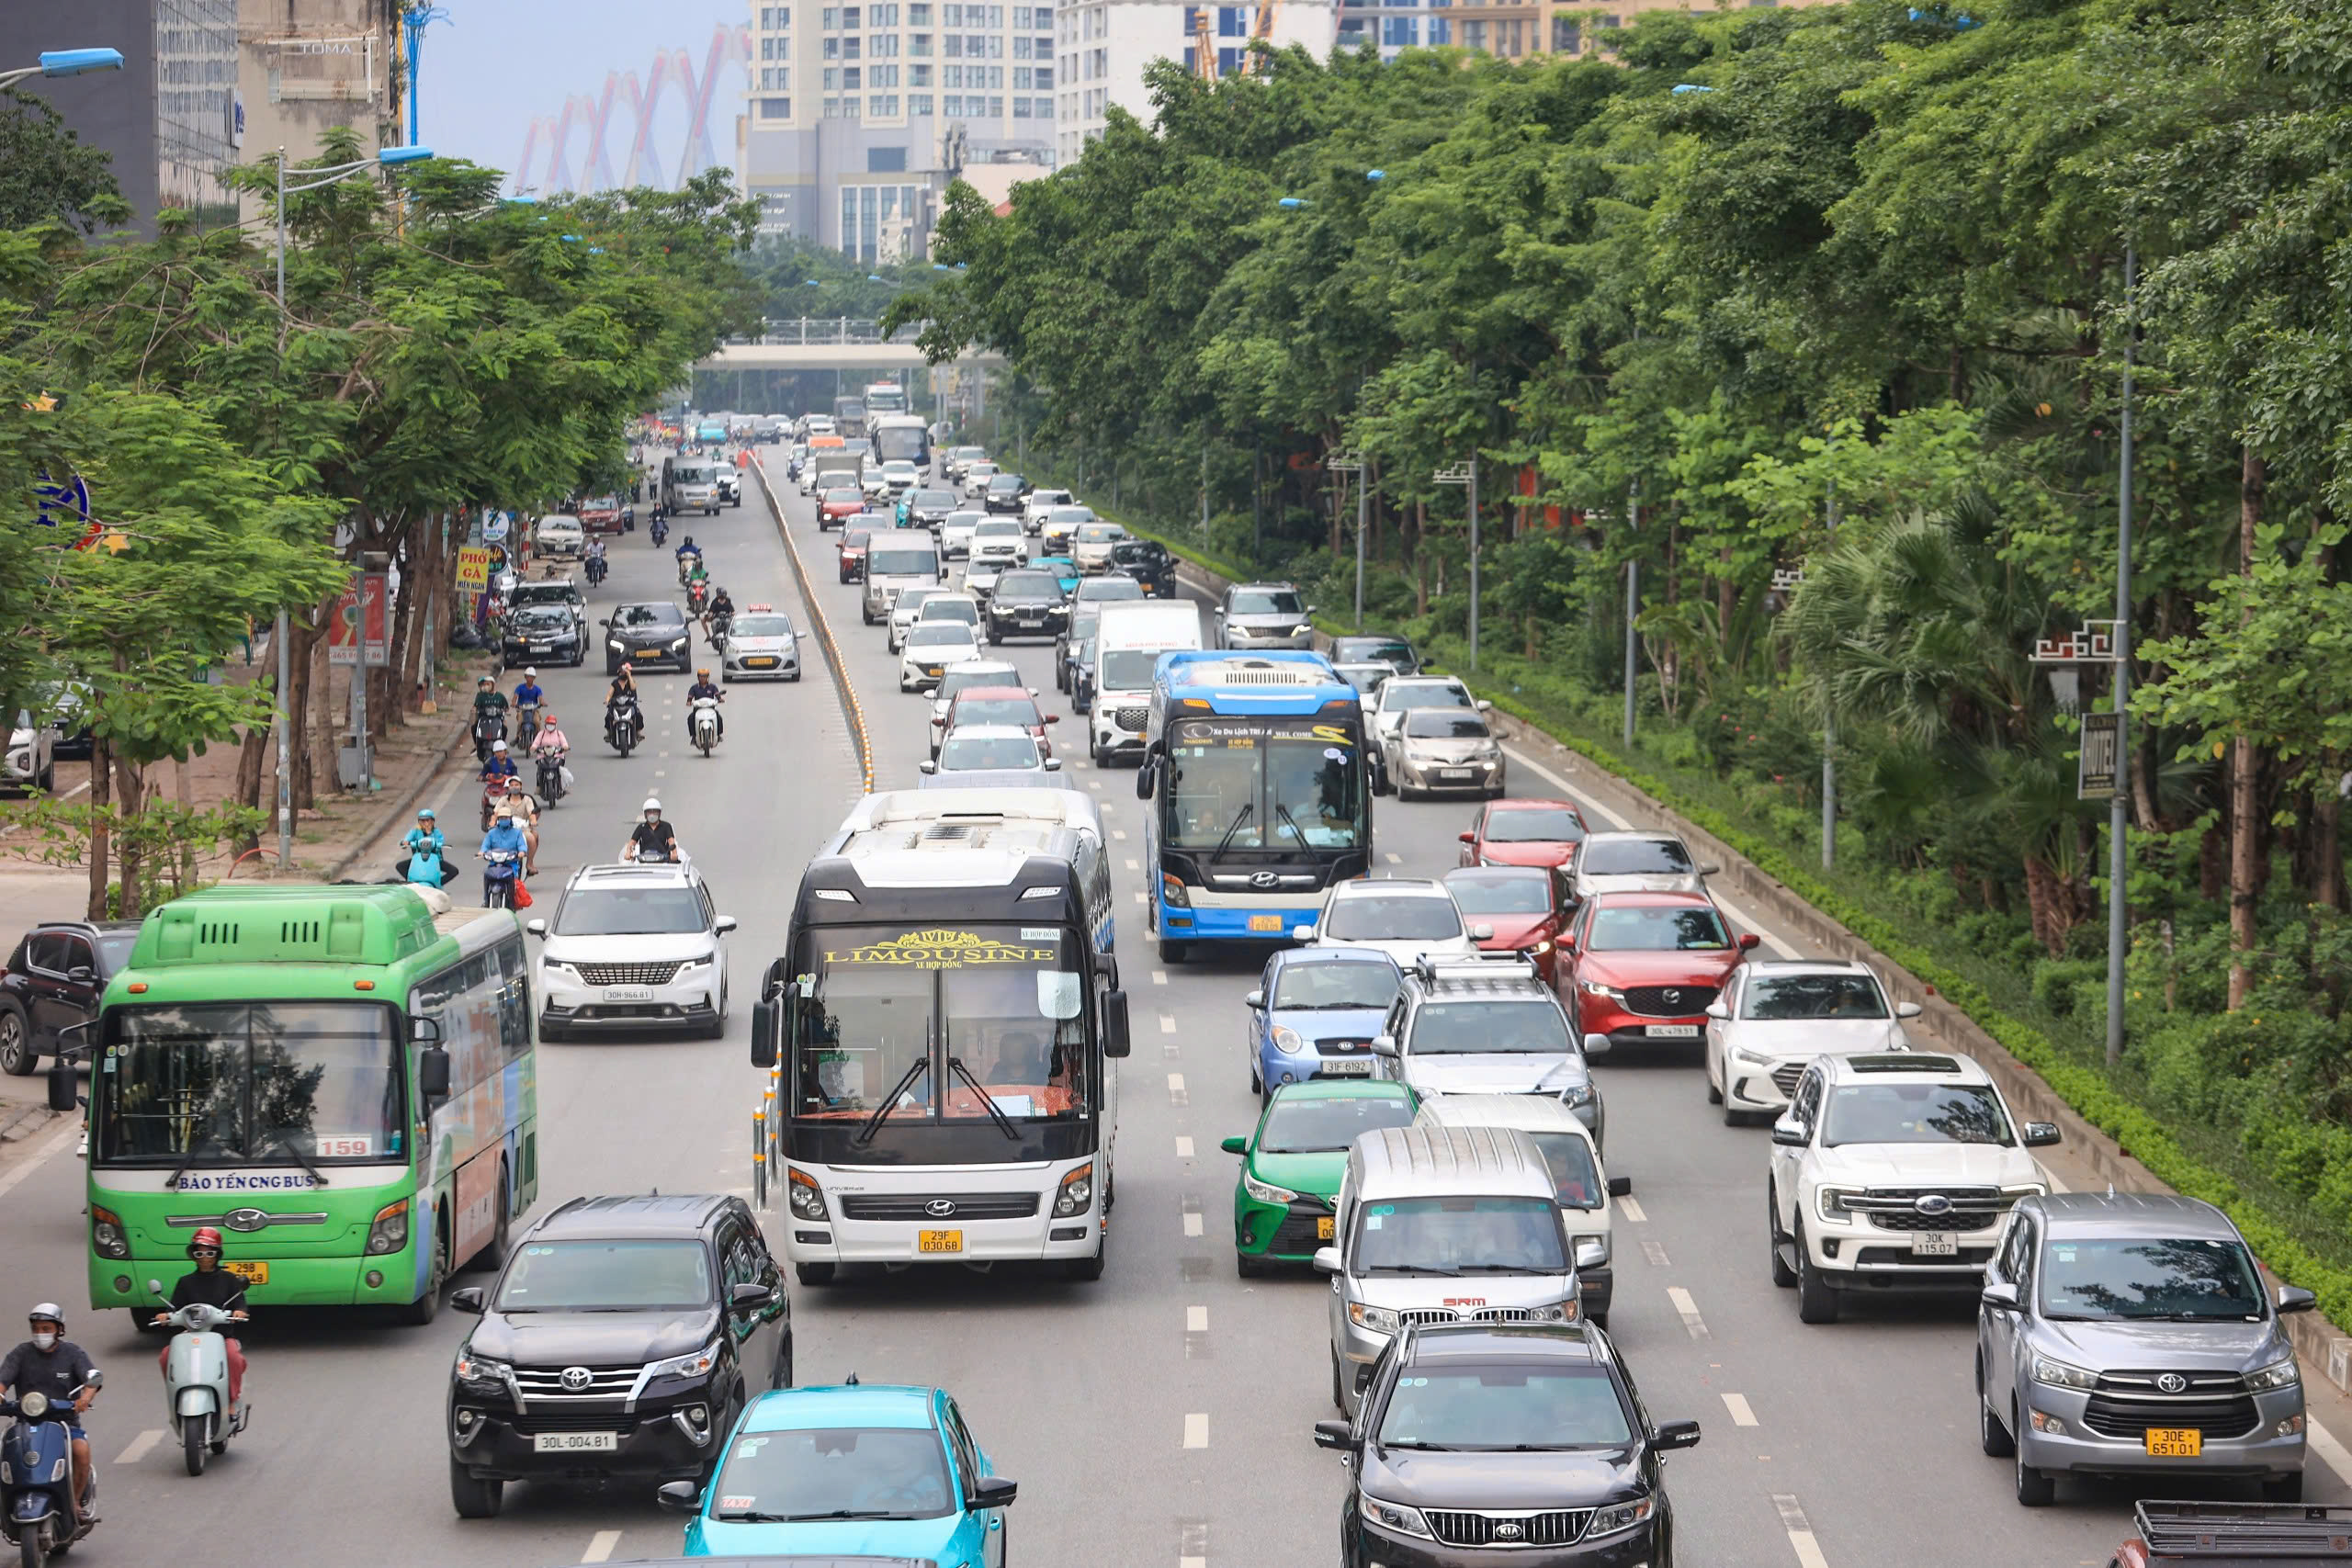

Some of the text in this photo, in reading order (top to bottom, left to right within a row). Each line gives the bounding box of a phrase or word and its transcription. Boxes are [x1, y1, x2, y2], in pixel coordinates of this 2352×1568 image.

[460, 550, 487, 564] PHỞ
[462, 566, 481, 579] GÀ
[1213, 728, 1223, 736] Xe
[1223, 728, 1234, 736] Du
[1234, 727, 1249, 737] Lịch
[2084, 729, 2115, 776] HOTEL
[922, 930, 956, 942] VIP
[824, 948, 1055, 963] LIMOUSINE
[915, 958, 962, 971] XE HỢP ĐỒNG
[322, 1141, 367, 1156] 159
[179, 1172, 211, 1190] BẢO
[215, 1172, 246, 1189] YẾN
[932, 1231, 950, 1241] 29F
[1925, 1234, 1944, 1244] 30K
[923, 1241, 957, 1251] 030.68
[1918, 1244, 1952, 1254] 115.07
[2162, 1430, 2185, 1442] 30E
[542, 1436, 608, 1449] 30L-004.81
[2153, 1443, 2193, 1455] 651.01
[722, 1498, 752, 1508] TAXI
[1499, 1526, 1519, 1536] KIA
